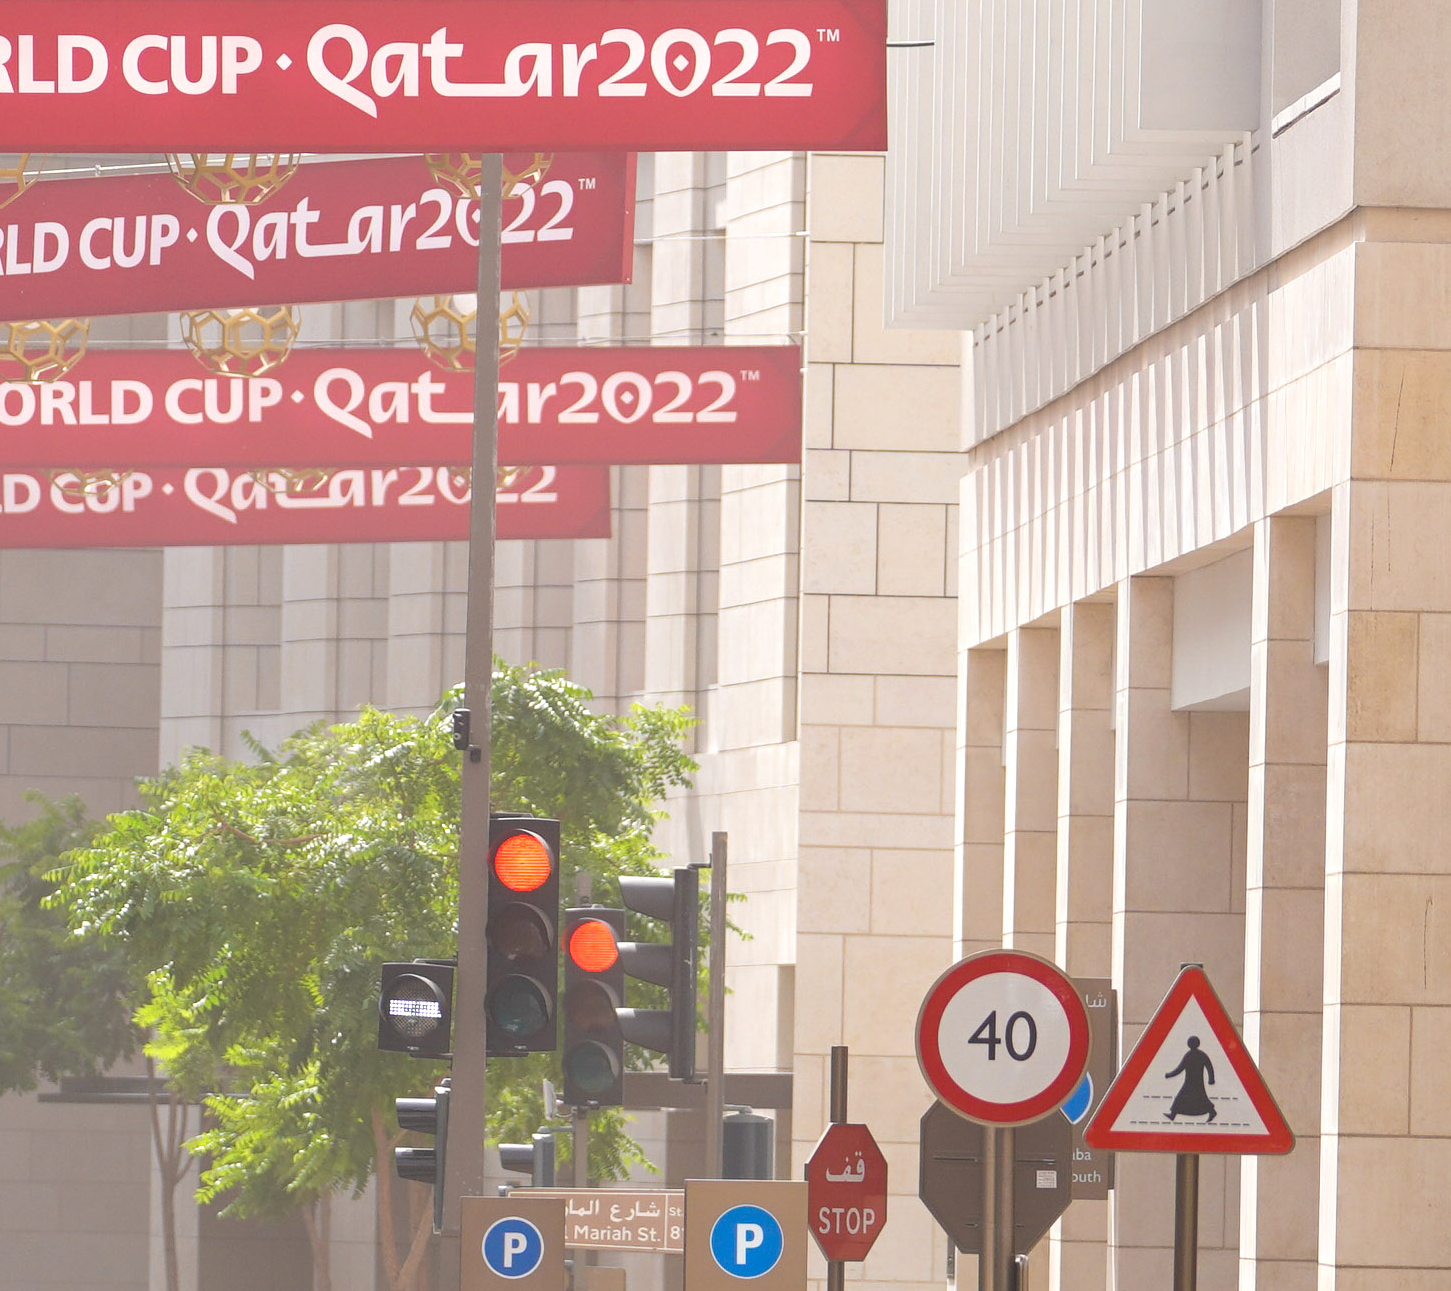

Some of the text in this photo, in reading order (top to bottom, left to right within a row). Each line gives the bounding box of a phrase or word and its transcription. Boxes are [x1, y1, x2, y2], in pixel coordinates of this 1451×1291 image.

[122, 34, 263, 95] CUP
[78, 214, 181, 270] CUP
[164, 377, 284, 424] CUP
[49, 472, 154, 514] CUP
[967, 1009, 1037, 1062] 40
[825, 1151, 866, 1183] قف
[609, 1201, 661, 1222] شارع
[818, 1205, 876, 1235] STOP
[503, 1232, 528, 1268] P
[574, 1225, 632, 1241] Mariah
[637, 1226, 661, 1242] St.
[736, 1223, 764, 1265] P
